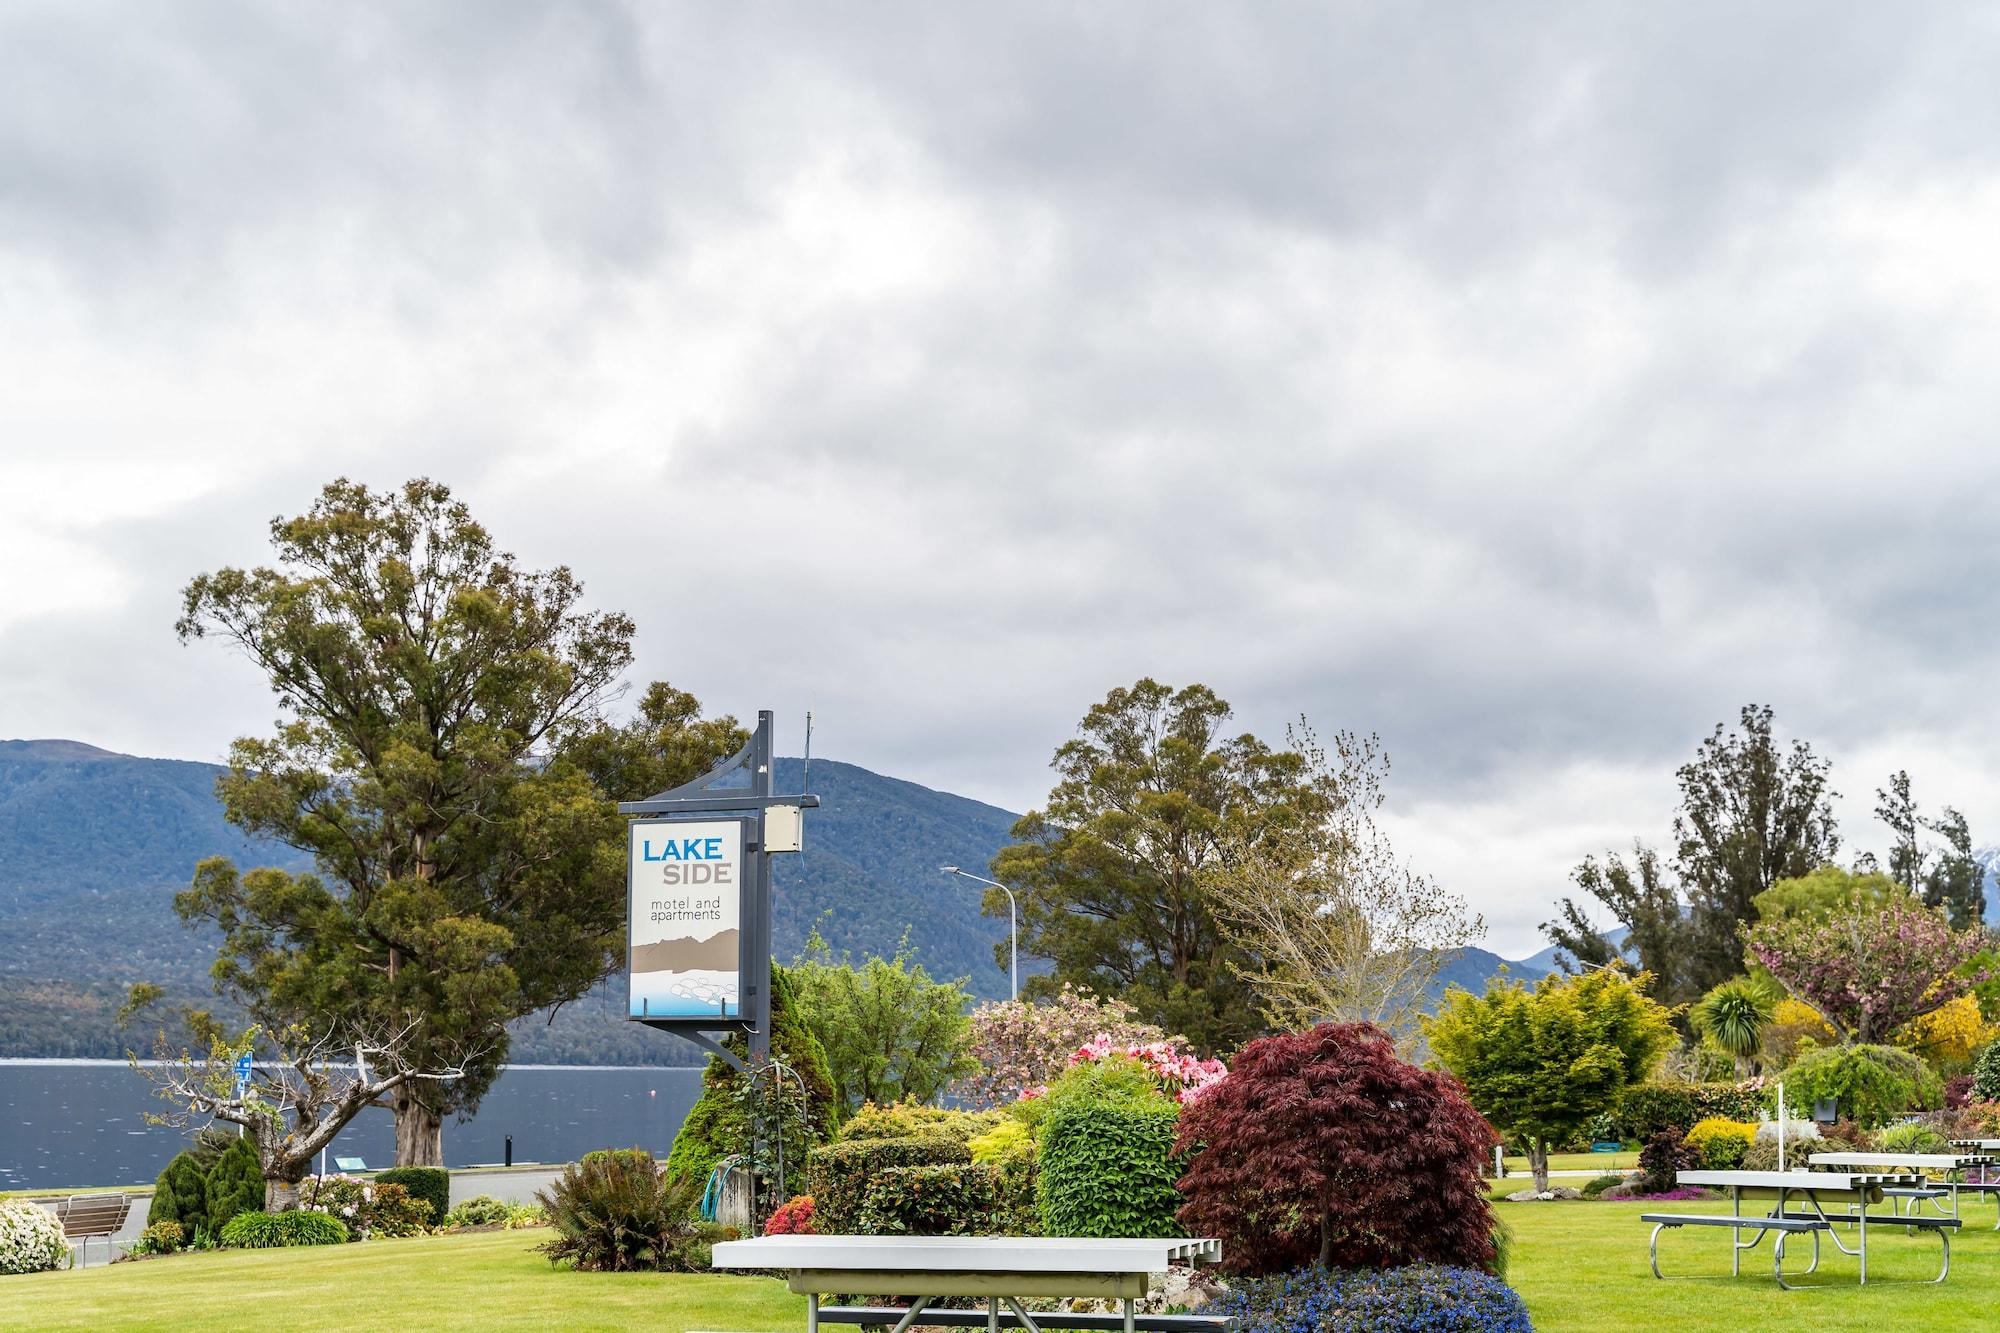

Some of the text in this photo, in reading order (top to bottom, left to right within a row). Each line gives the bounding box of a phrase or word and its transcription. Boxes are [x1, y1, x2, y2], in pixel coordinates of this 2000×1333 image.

[643, 837, 723, 861] LAKE
[663, 862, 732, 885] SIDE
[651, 896, 720, 910] motel and
[650, 908, 721, 924] apartments
